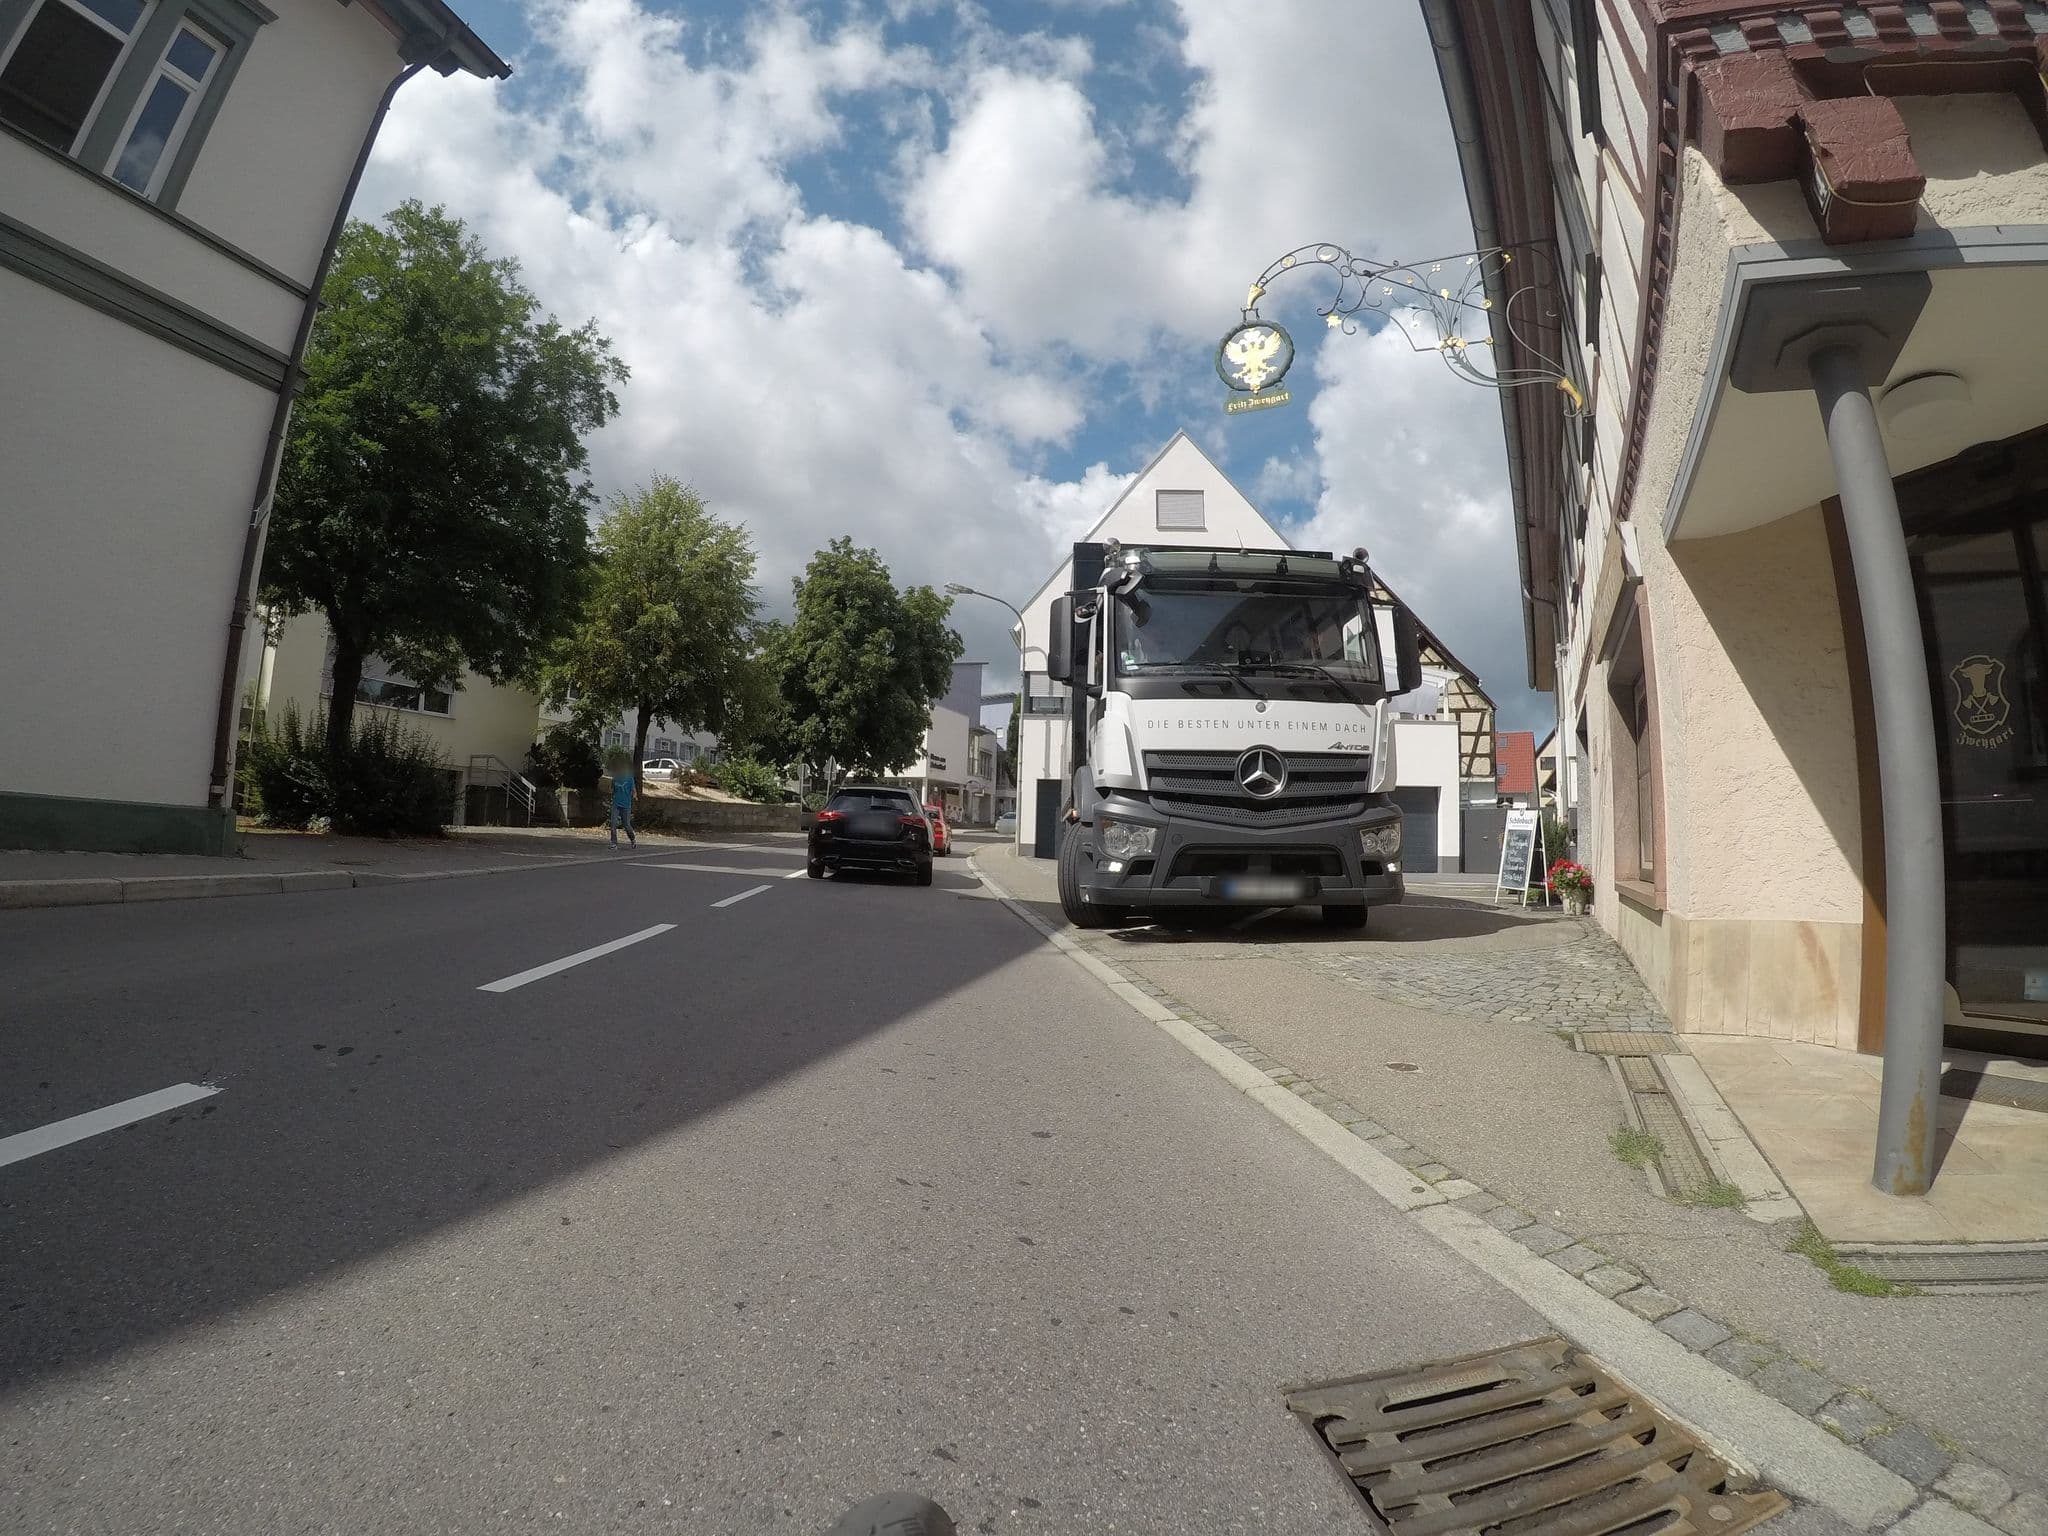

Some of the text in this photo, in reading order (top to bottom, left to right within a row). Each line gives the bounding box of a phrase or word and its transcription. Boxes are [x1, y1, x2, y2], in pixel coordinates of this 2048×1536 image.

[1147, 719, 1366, 733] DIE BESTEN UNTER EINEM DACH
[1956, 727, 2015, 749] Zweygart
